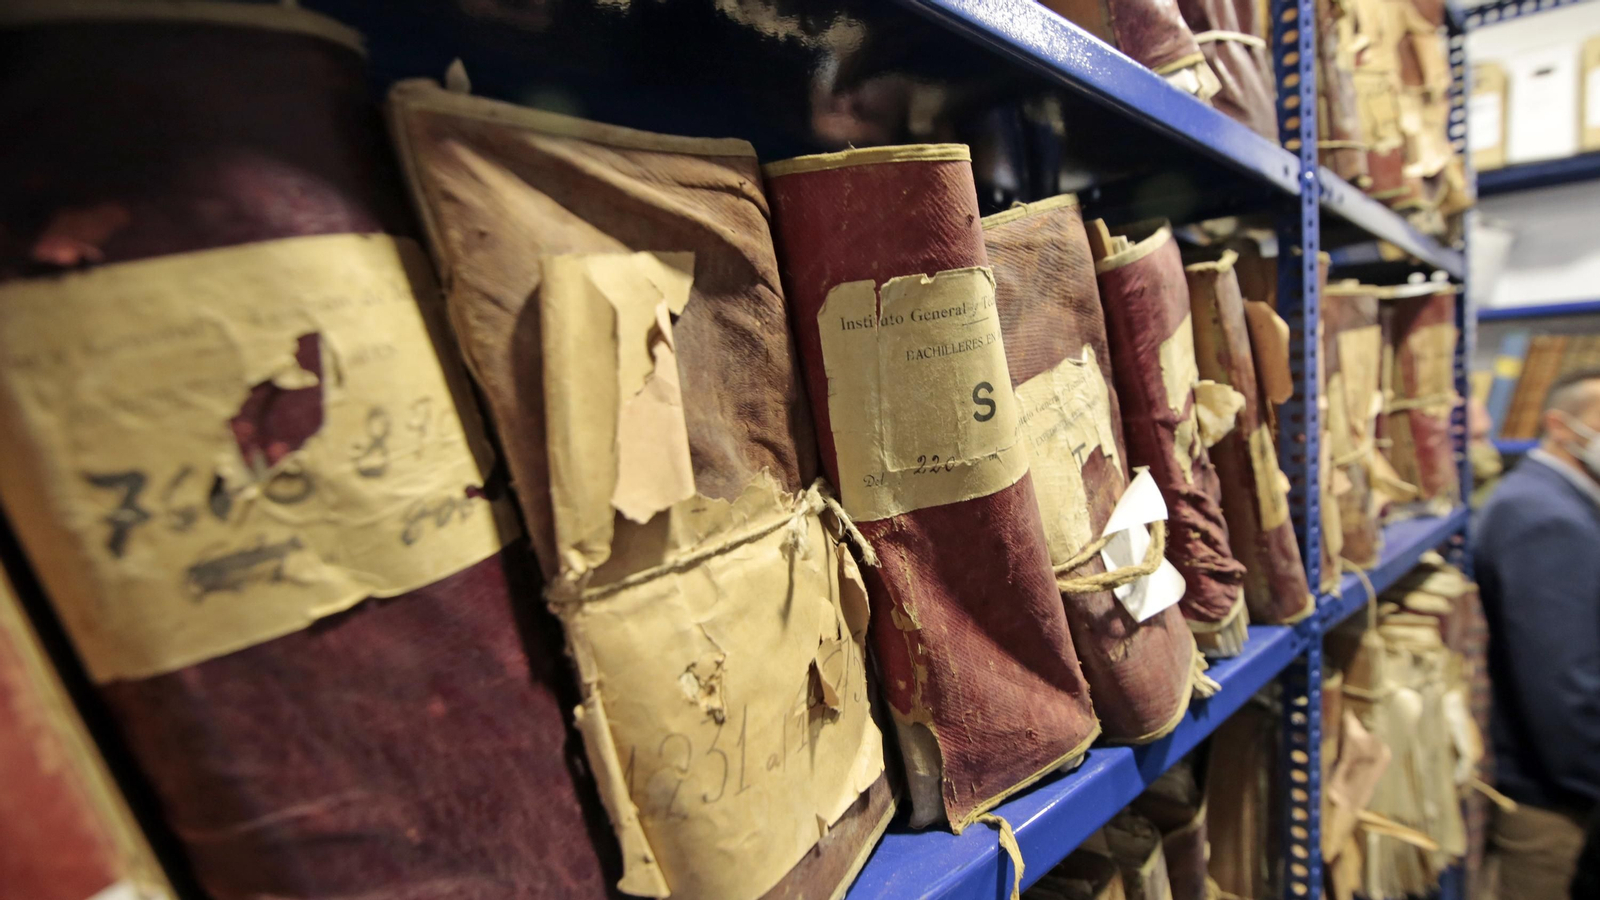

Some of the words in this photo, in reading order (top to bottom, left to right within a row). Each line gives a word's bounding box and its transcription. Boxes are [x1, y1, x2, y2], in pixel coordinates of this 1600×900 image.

[840, 314, 904, 331] Instiuto
[910, 302, 966, 323] General
[906, 336, 984, 361] BACHILLERES
[972, 381, 996, 422] S
[1072, 442, 1087, 466] T
[863, 473, 885, 488] Del
